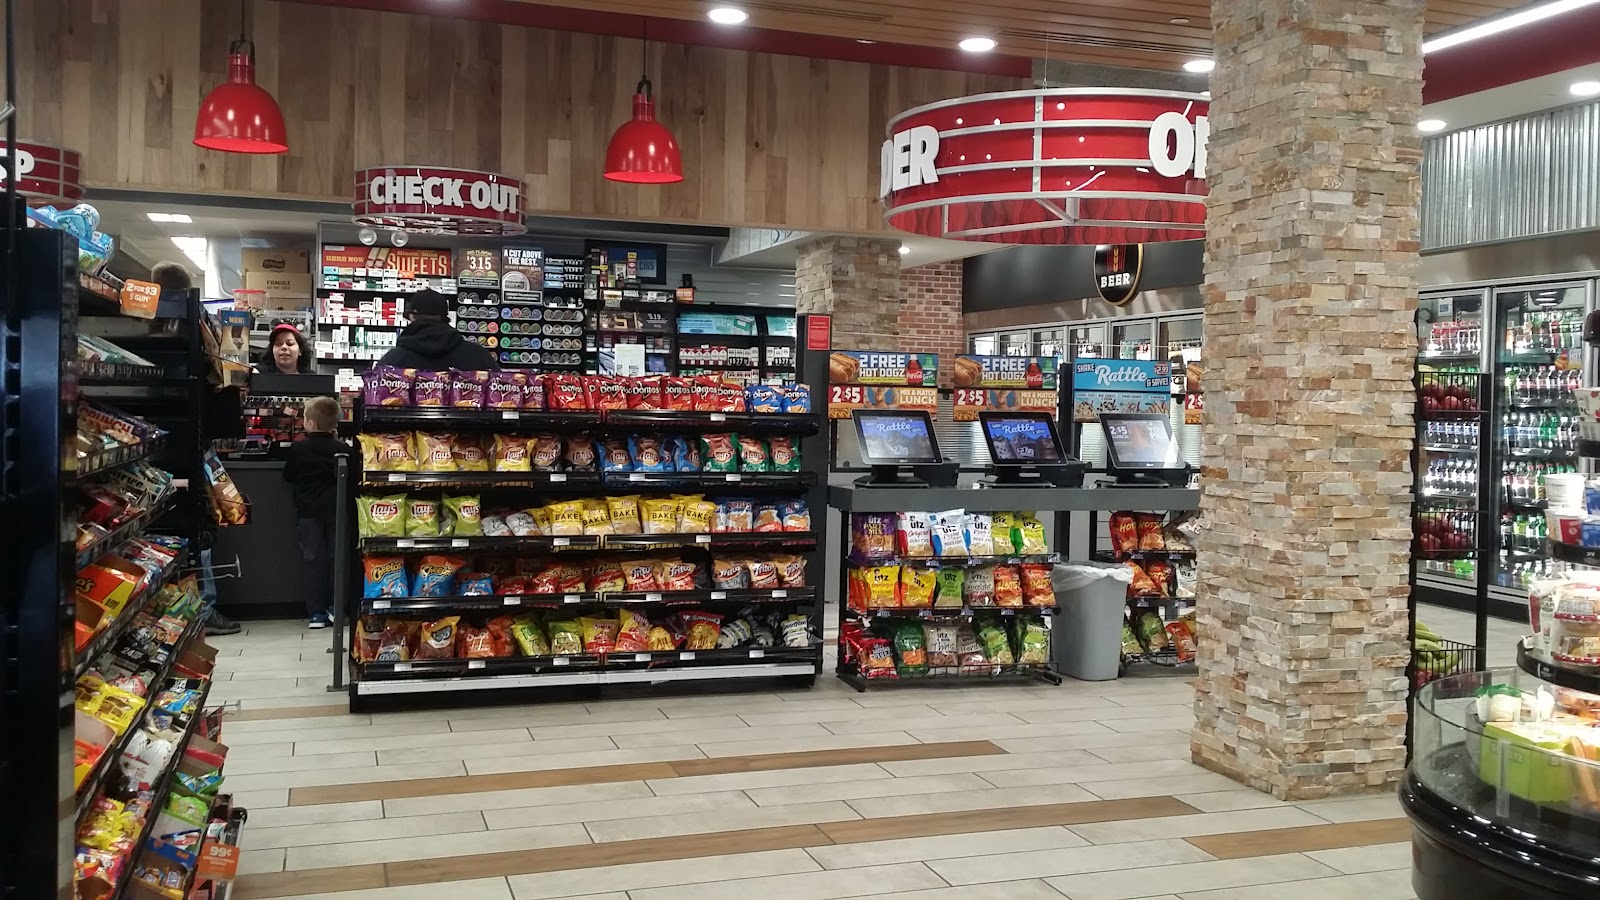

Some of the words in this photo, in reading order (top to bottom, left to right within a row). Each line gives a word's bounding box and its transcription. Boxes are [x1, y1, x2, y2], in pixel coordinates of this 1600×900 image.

[370, 176, 464, 208] CHECK
[470, 180, 519, 213] OUT
[509, 250, 521, 258] CUT
[522, 250, 542, 259] ABOVE
[386, 252, 448, 277] SWEETS
[508, 257, 520, 265] THE
[1100, 273, 1131, 288] BEER
[126, 283, 134, 292] 2
[145, 286, 158, 296] $3
[134, 294, 149, 303] GUM
[859, 354, 869, 368] 2
[870, 354, 906, 368] FREE
[982, 358, 991, 371] 2
[992, 358, 1026, 371] FREE
[859, 368, 877, 378] HOT
[880, 368, 906, 378] DOGZ
[1076, 363, 1095, 373] SHAKE
[982, 371, 998, 381] HOT
[1002, 371, 1026, 381] DOGZ
[1095, 364, 1148, 386] Rattle
[380, 379, 410, 390] Doritos
[415, 381, 444, 390] Doritos
[453, 380, 483, 391] Doritos
[490, 382, 520, 393] Doritos
[1151, 377, 1169, 387] SAVE!
[632, 386, 660, 395] Doritos
[832, 386, 841, 403] 2
[900, 396, 936, 405] LUNCH
[957, 389, 966, 406] 2
[1020, 398, 1055, 407] LUNCH
[1187, 394, 1195, 409] 2
[876, 421, 912, 432] Rattle
[1002, 423, 1036, 434] Rattle
[868, 516, 882, 524] utz
[910, 520, 925, 529] utz
[944, 573, 957, 582] utz
